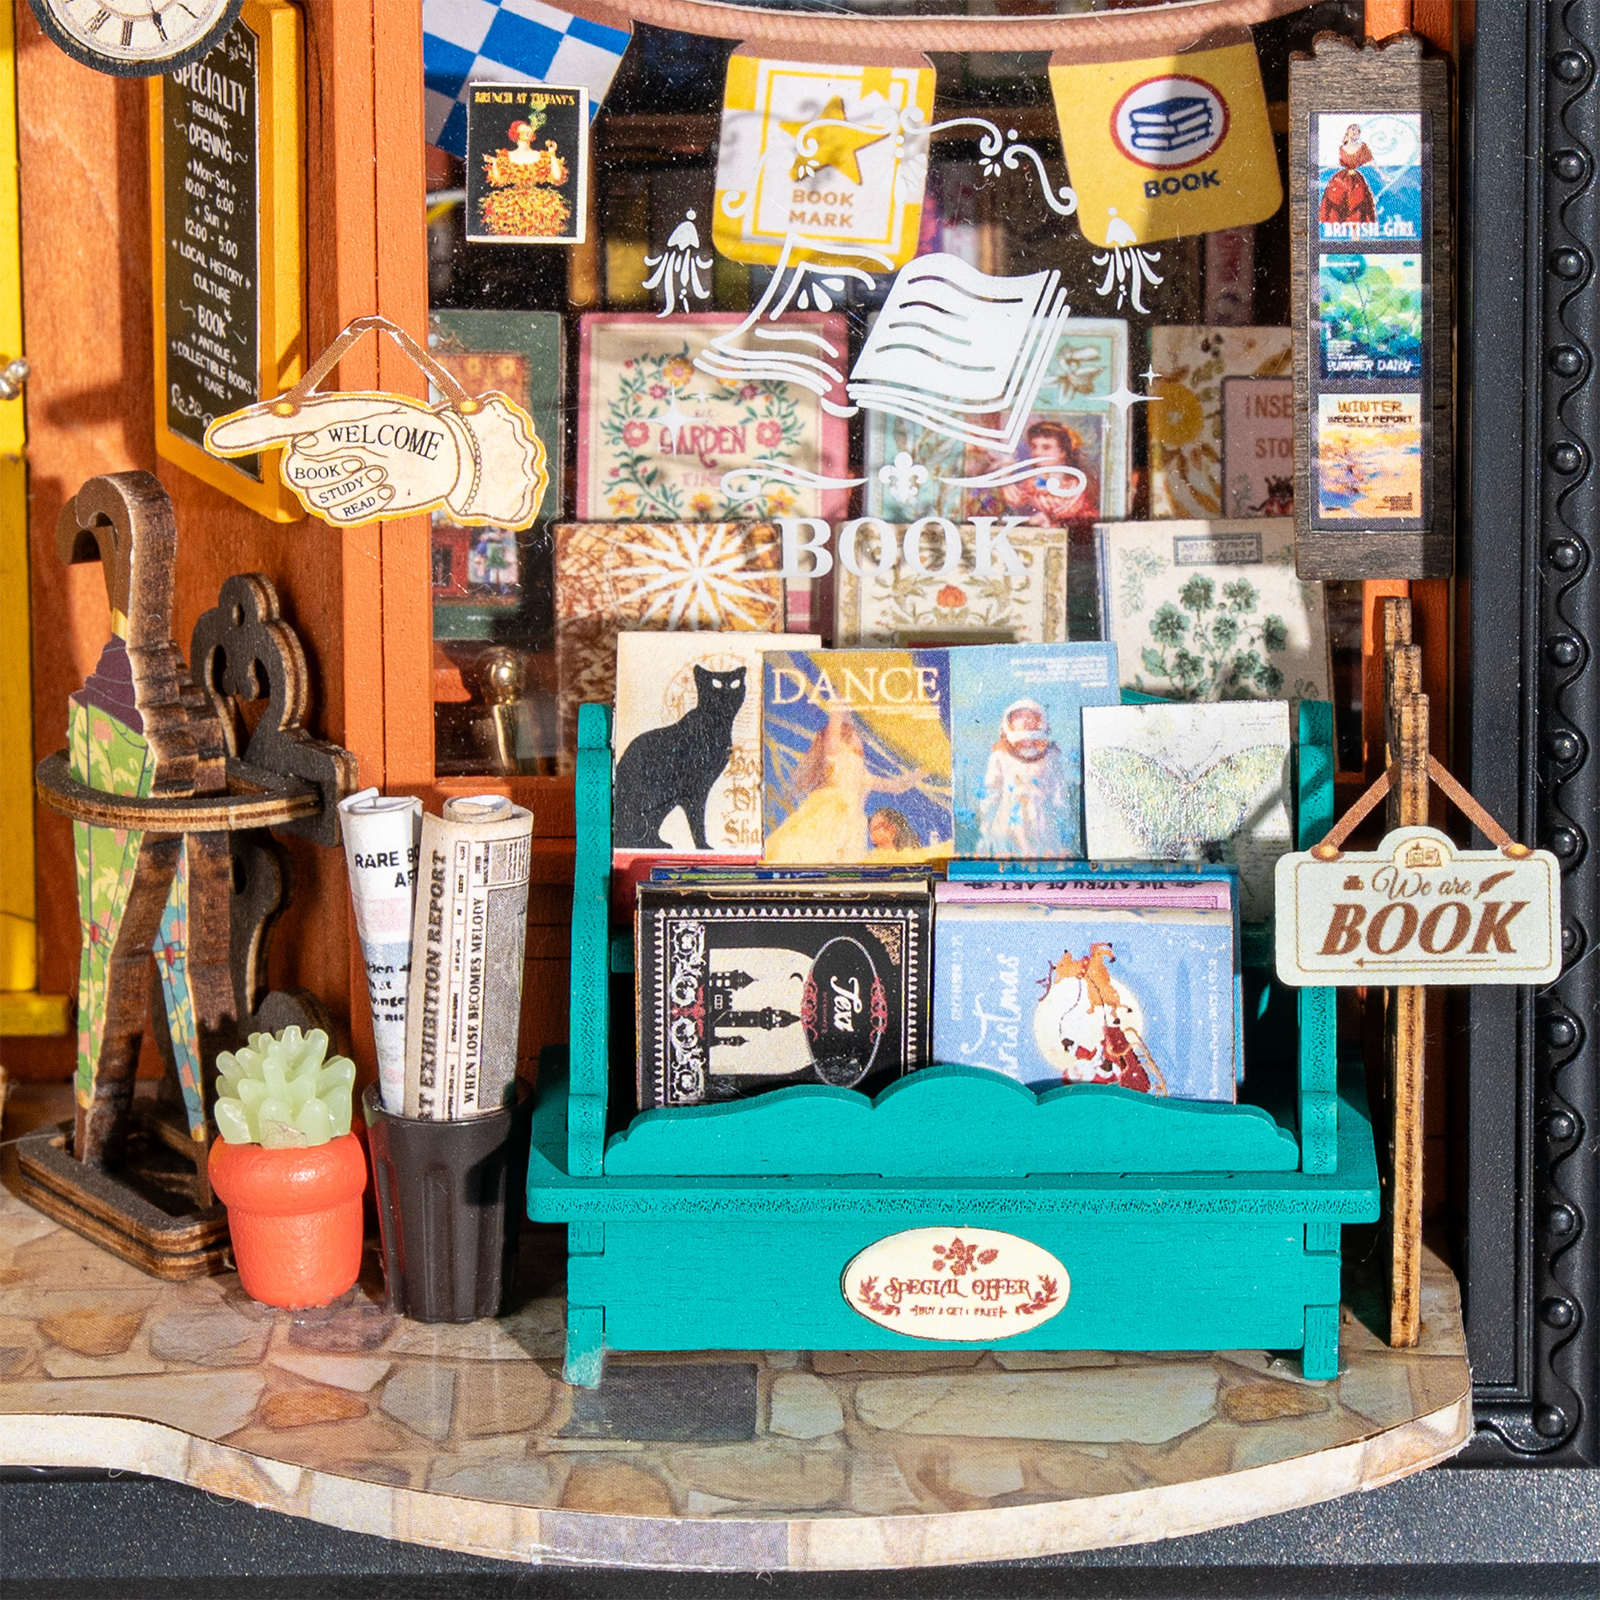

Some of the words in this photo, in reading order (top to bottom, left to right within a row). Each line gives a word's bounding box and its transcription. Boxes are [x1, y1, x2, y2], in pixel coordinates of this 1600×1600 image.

[189, 122, 232, 164] OPENING
[792, 189, 854, 206] BOOK
[1144, 169, 1221, 198] BOOK
[203, 205, 219, 228] Sun
[789, 210, 853, 228] MARK
[180, 241, 207, 268] LOCAL
[210, 257, 243, 287] HISTORY
[193, 272, 231, 305] CULTURE
[198, 305, 226, 338] BOOK
[204, 376, 225, 399] RARE
[1328, 415, 1370, 424] WEEKLY
[1338, 400, 1402, 413] WINTER
[328, 425, 444, 461] WELCOME
[659, 425, 746, 468] GARDEN
[294, 465, 341, 480] BOOK
[318, 477, 364, 504] STUDY
[343, 497, 376, 517] READ
[772, 516, 1030, 578] BOOK
[771, 667, 941, 705] DANCE
[354, 850, 400, 868] RARE
[428, 850, 446, 944] REPORT
[1371, 865, 1433, 900] We
[1438, 877, 1473, 895] are
[471, 898, 485, 953] MELODY
[1317, 901, 1531, 956] BOOK
[468, 957, 483, 1020] BECOMES
[419, 948, 441, 1088] EXHIBITION
[467, 1024, 479, 1058] LOSE
[464, 1061, 477, 1104] WHEN
[884, 1277, 968, 1303] SPECIAL
[972, 1277, 1033, 1301] OFFER
